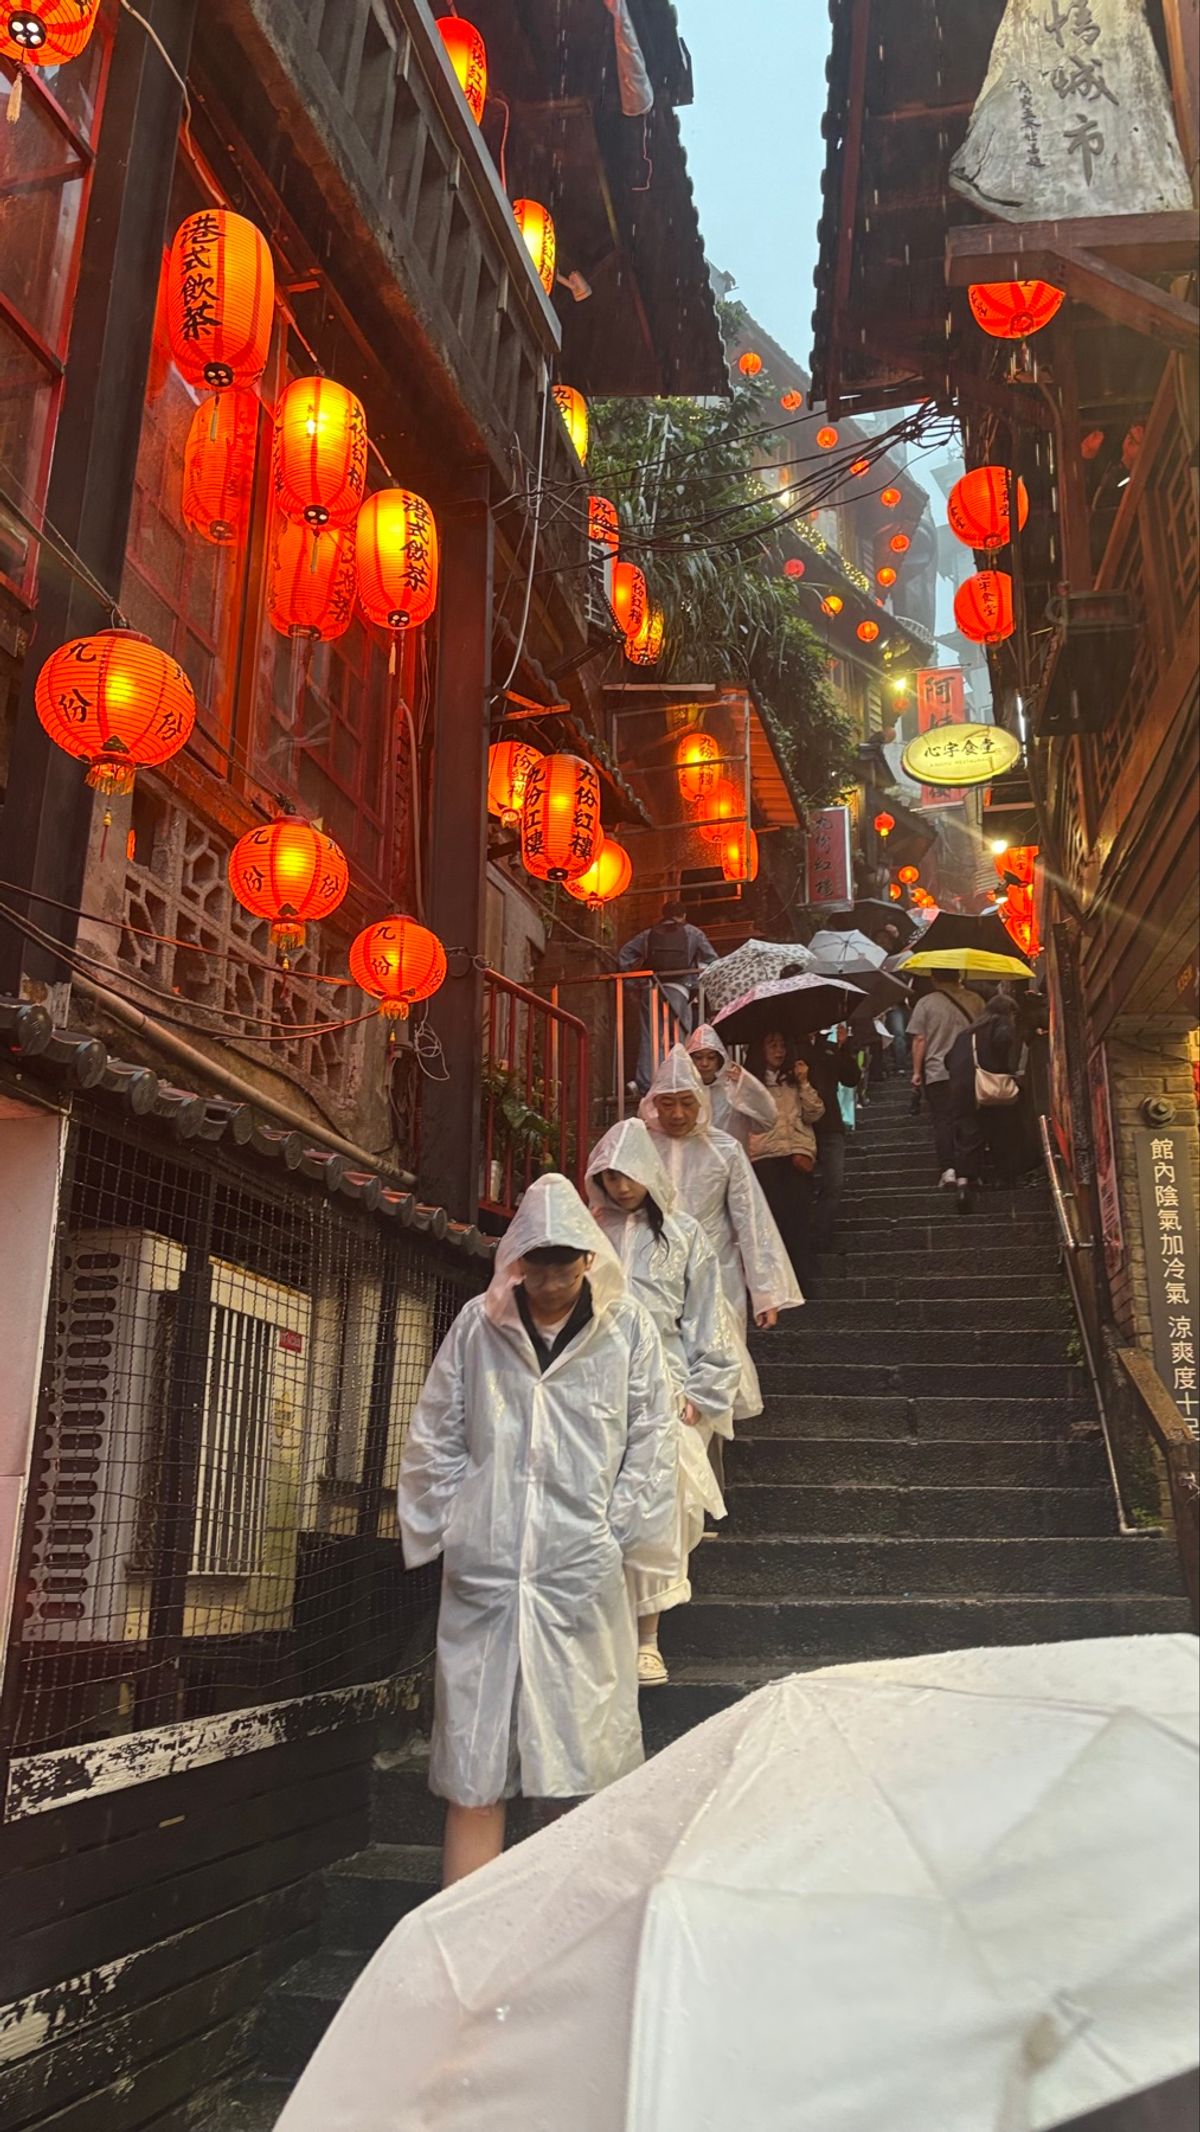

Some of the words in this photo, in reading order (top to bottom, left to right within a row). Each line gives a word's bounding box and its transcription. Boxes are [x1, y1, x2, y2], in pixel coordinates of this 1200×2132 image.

[178, 213, 227, 341] 港式飲茶
[59, 642, 97, 724] 九份
[924, 737, 997, 758] 心字食堂
[569, 765, 599, 861] 九份紅樓
[243, 829, 270, 893] 九份
[372, 925, 397, 976] 九份
[1150, 1138, 1190, 1306] 館內陰氣加冷氣
